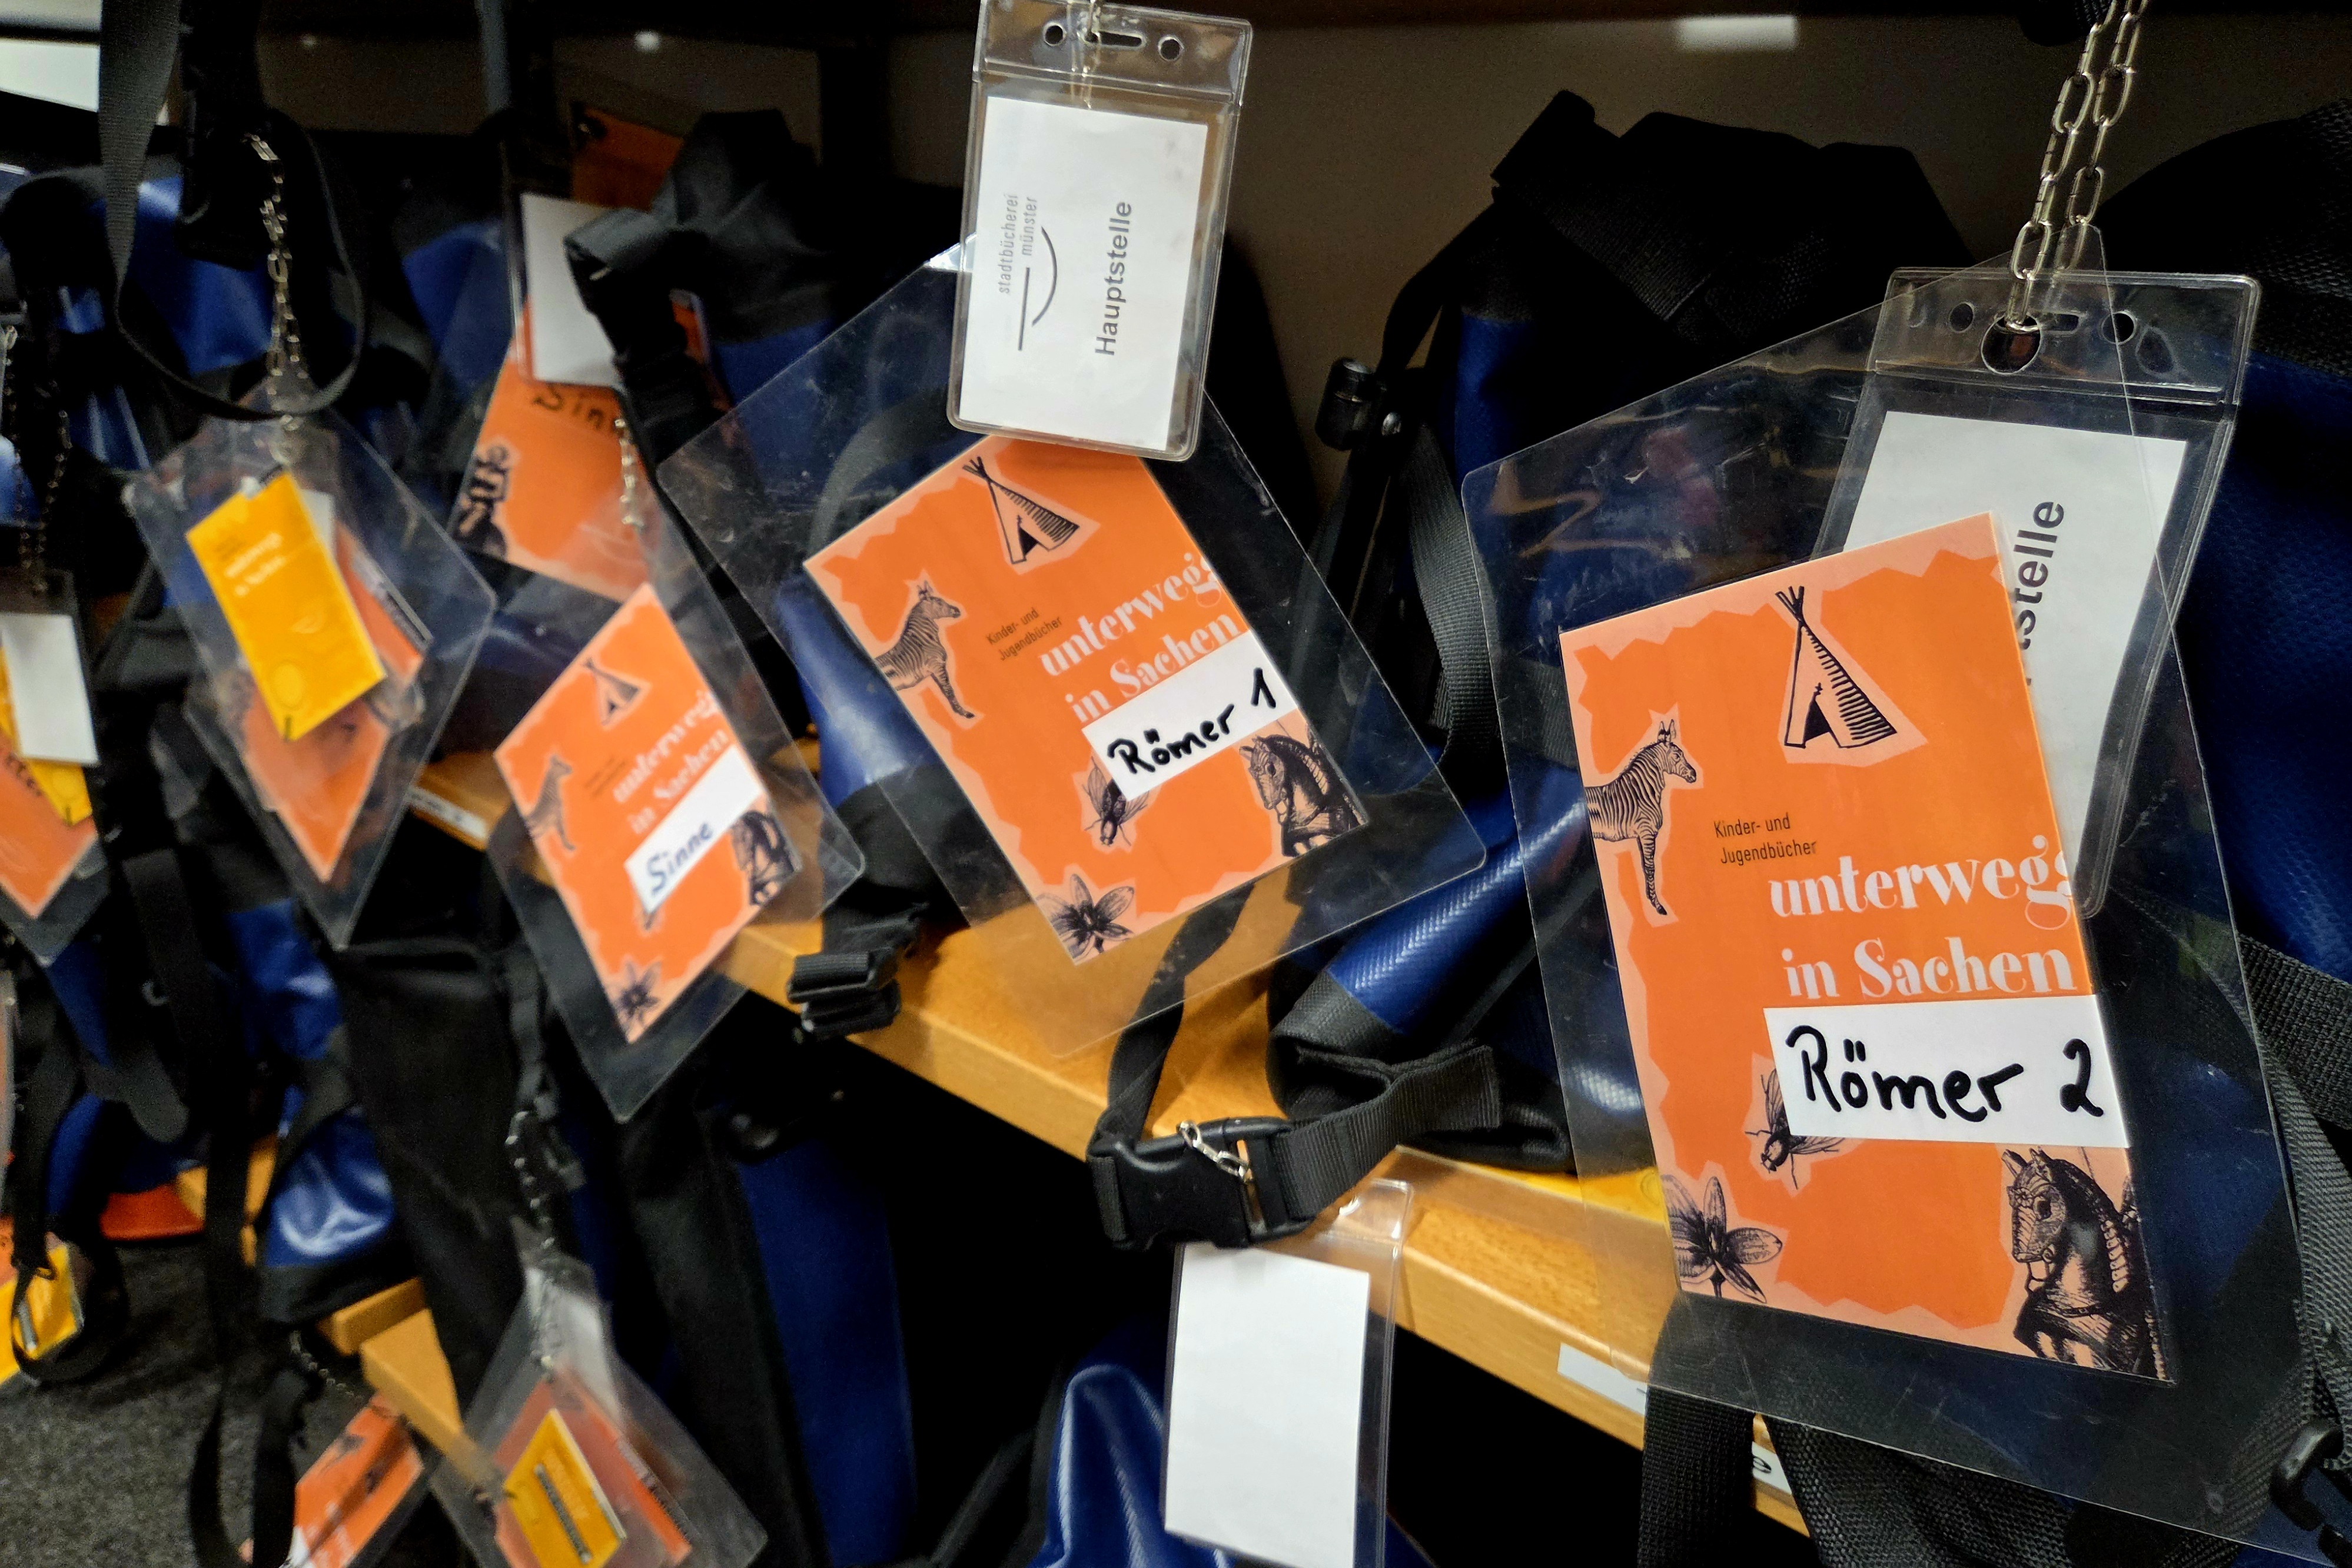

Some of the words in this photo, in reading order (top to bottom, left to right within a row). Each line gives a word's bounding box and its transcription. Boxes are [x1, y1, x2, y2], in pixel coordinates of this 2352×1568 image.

[998, 193, 1018, 295] stadtbücherei
[1021, 197, 1037, 256] münster
[1095, 201, 1132, 356] Hauptstelle
[986, 622, 1018, 645] Kinder-
[1021, 607, 1039, 624] und
[2009, 501, 2064, 686] stelle
[998, 616, 1062, 660] Jugendbücher
[1065, 693, 1111, 723] in
[1110, 613, 1241, 697] Sachen
[1107, 703, 1235, 774] Römer
[1251, 667, 1277, 709] 1
[646, 822, 714, 896] Sinne
[1714, 818, 1760, 838] Kinder-
[1766, 812, 1790, 832] und
[1720, 839, 1818, 866] Jugendbücher
[1781, 948, 1839, 999] in
[1853, 936, 2078, 999] Sachen
[1785, 1024, 2025, 1122] Römer
[2059, 1038, 2105, 1118] 2
